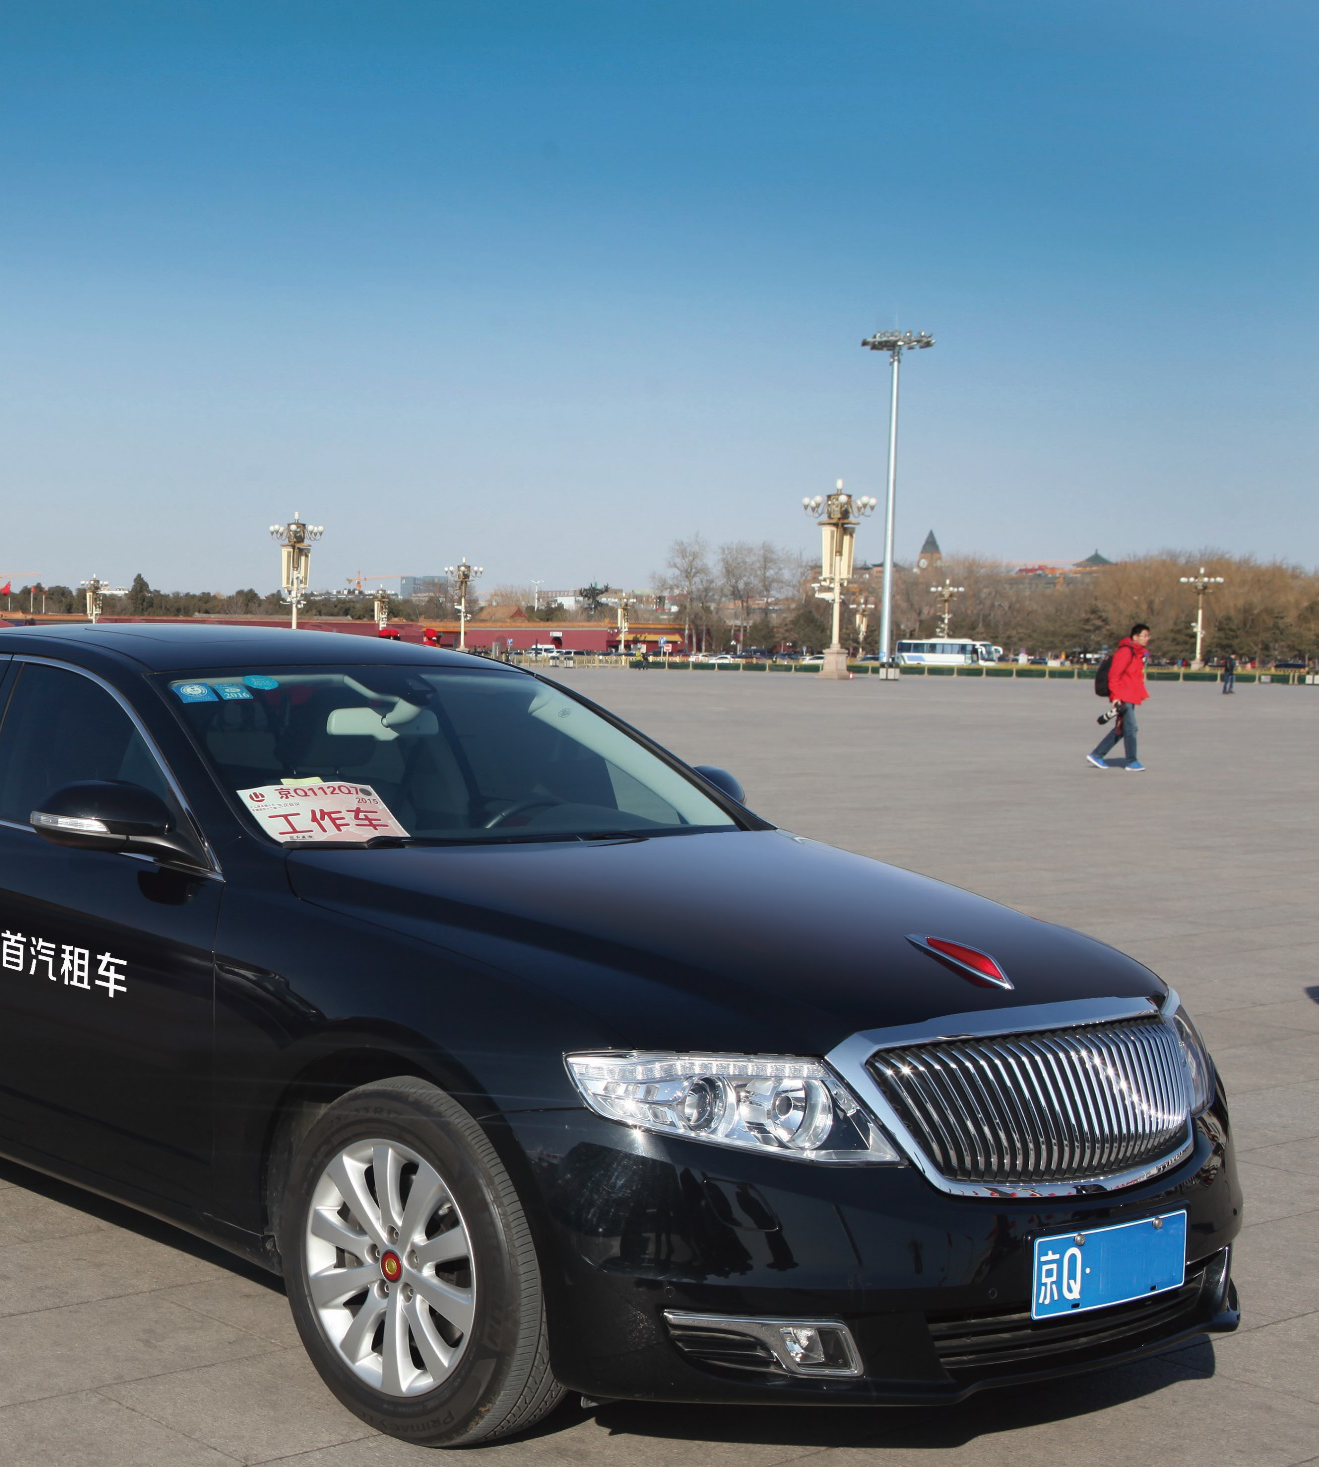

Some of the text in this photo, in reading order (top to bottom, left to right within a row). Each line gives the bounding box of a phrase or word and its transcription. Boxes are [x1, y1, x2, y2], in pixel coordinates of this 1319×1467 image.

[274, 785, 360, 799] 京Q112Q7
[356, 797, 379, 805] 2015
[268, 807, 389, 835] 工作车
[1, 930, 128, 998] 首汽租车
